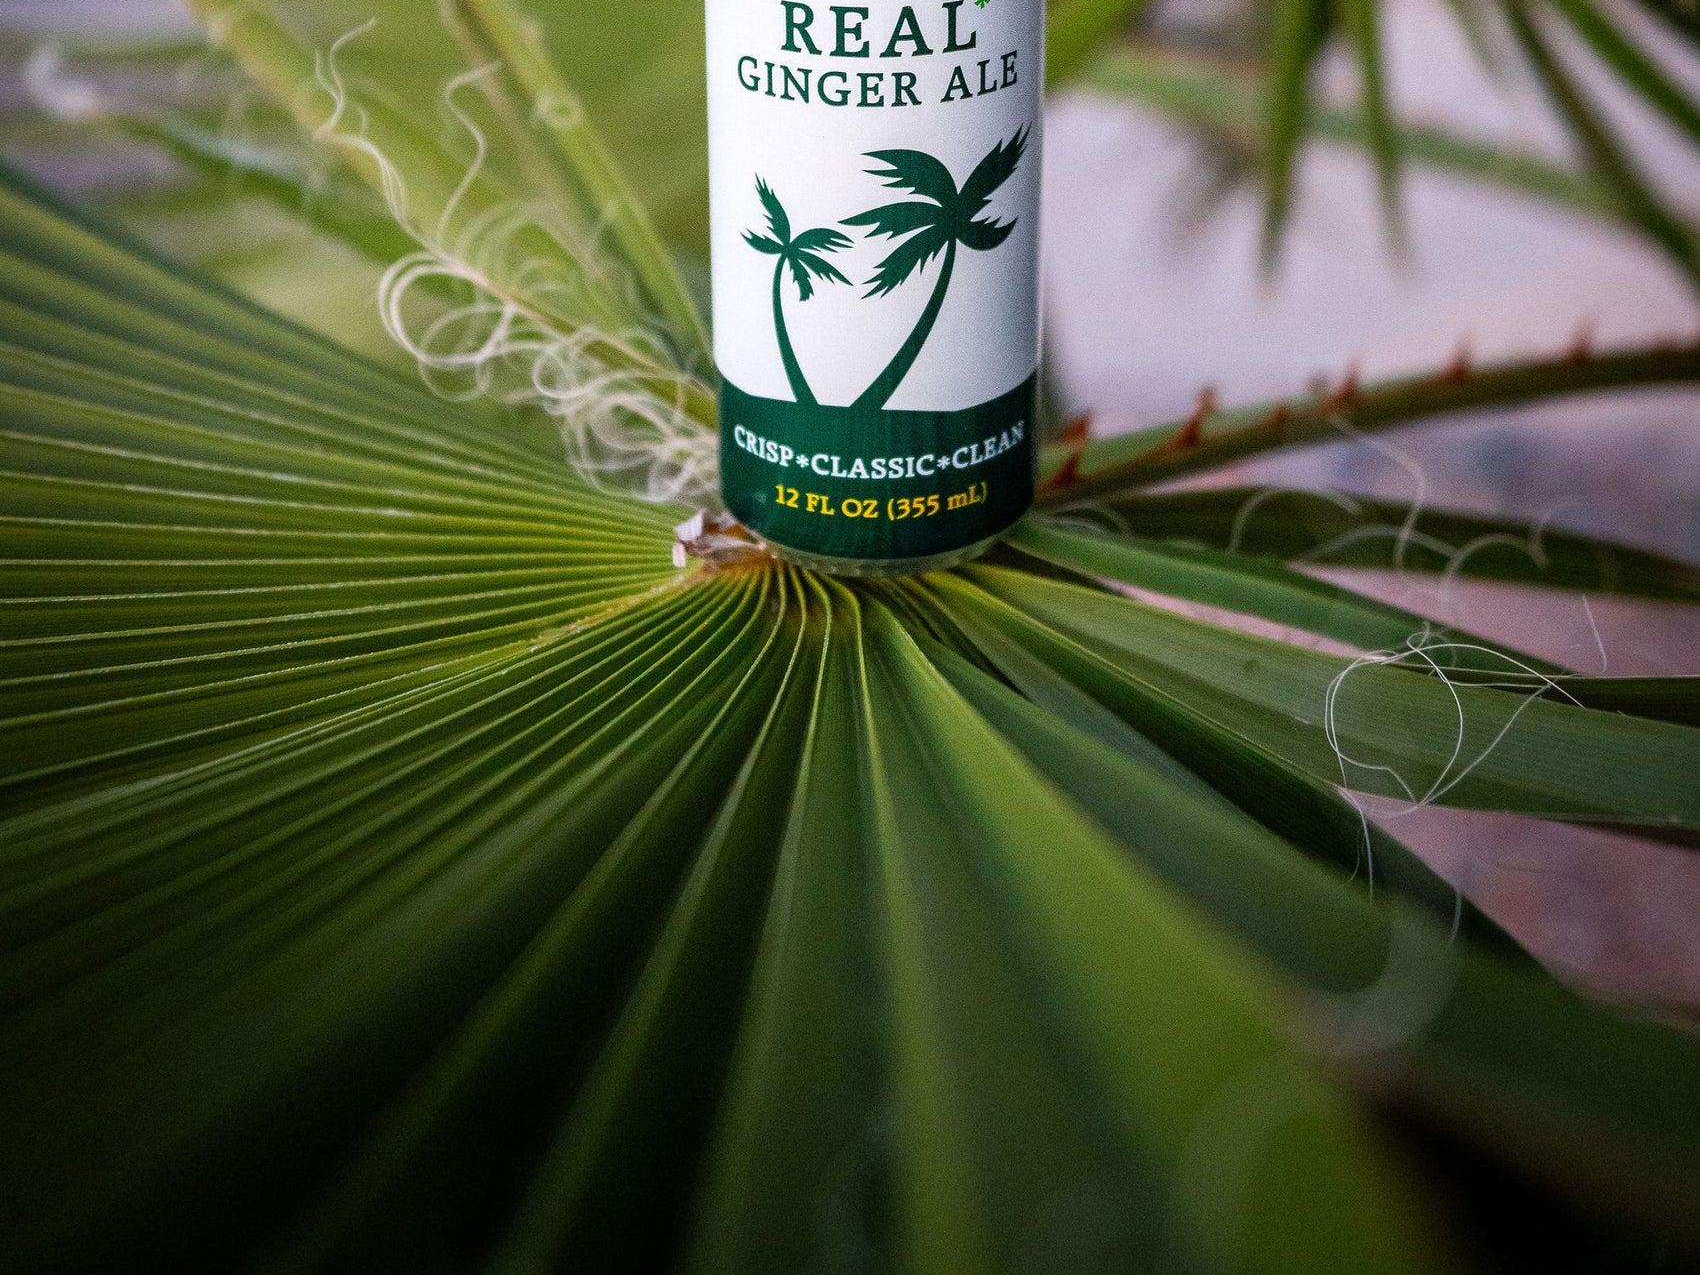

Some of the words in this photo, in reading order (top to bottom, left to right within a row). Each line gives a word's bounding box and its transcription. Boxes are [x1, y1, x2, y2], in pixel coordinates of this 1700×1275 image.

[737, 55, 923, 108] GINGER
[940, 50, 1018, 103] ALE
[775, 484, 799, 509] 12
[806, 492, 834, 517] FL
[842, 498, 880, 519] OZ
[887, 493, 940, 521] (355
[947, 481, 988, 511] mL)
